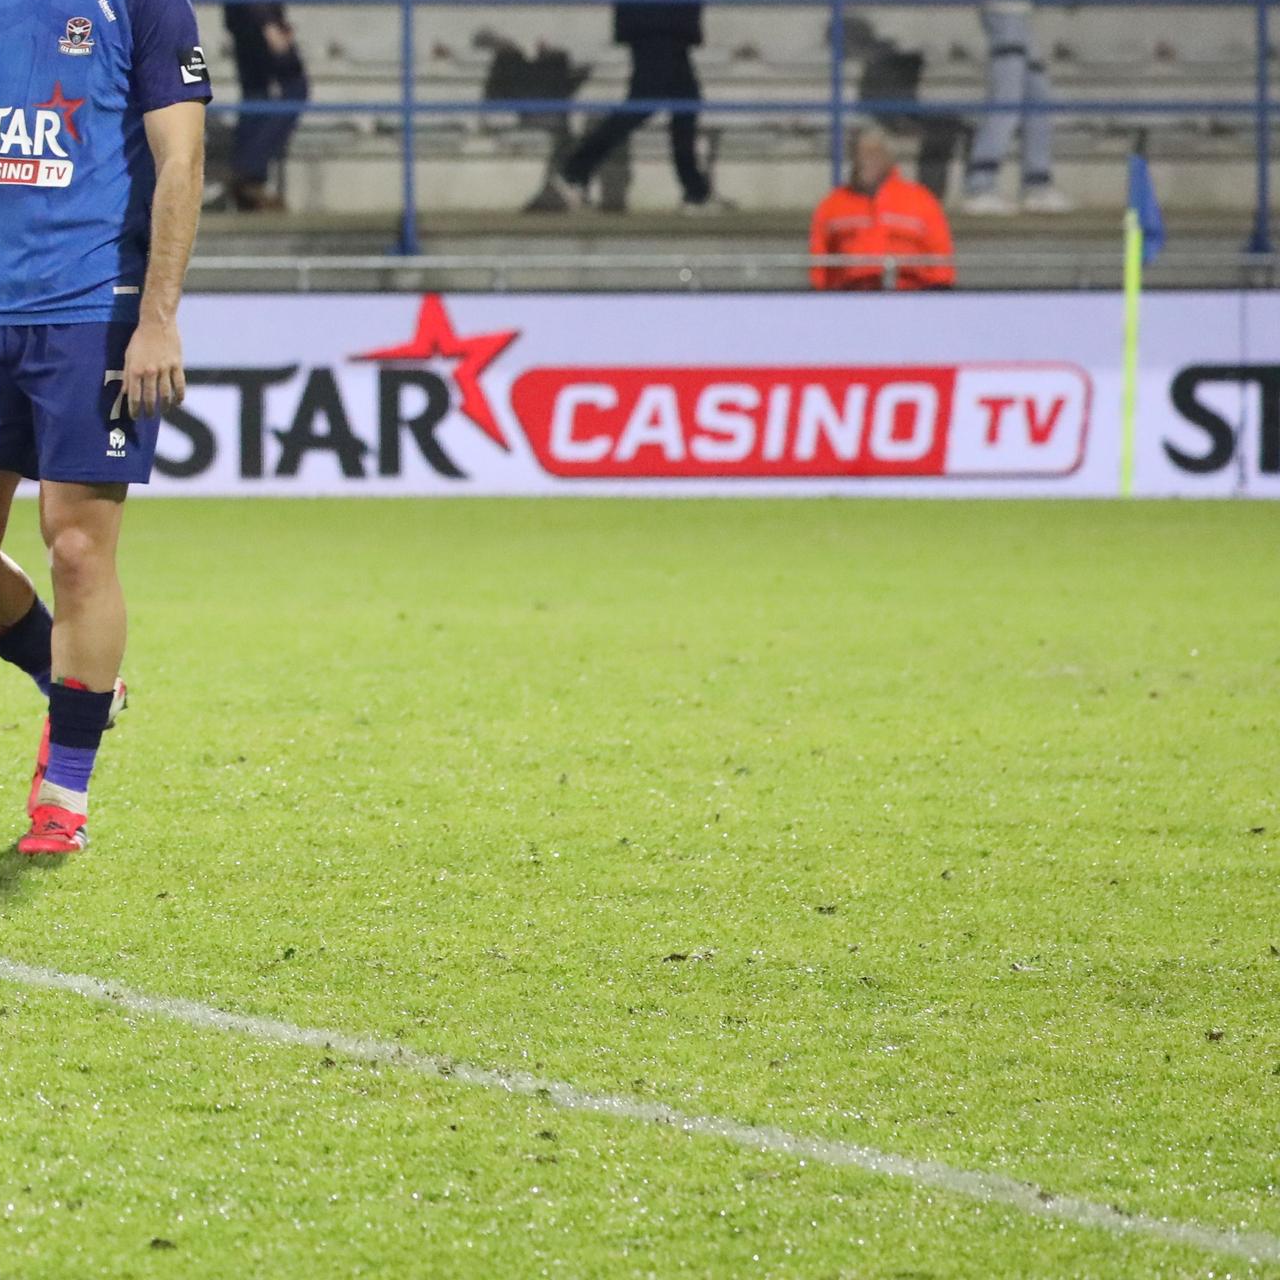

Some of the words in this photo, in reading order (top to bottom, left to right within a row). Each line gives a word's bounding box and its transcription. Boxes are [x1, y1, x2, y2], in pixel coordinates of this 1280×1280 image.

[44, 166, 67, 181] TV
[549, 382, 939, 462] CASINO
[977, 398, 1067, 446] TV
